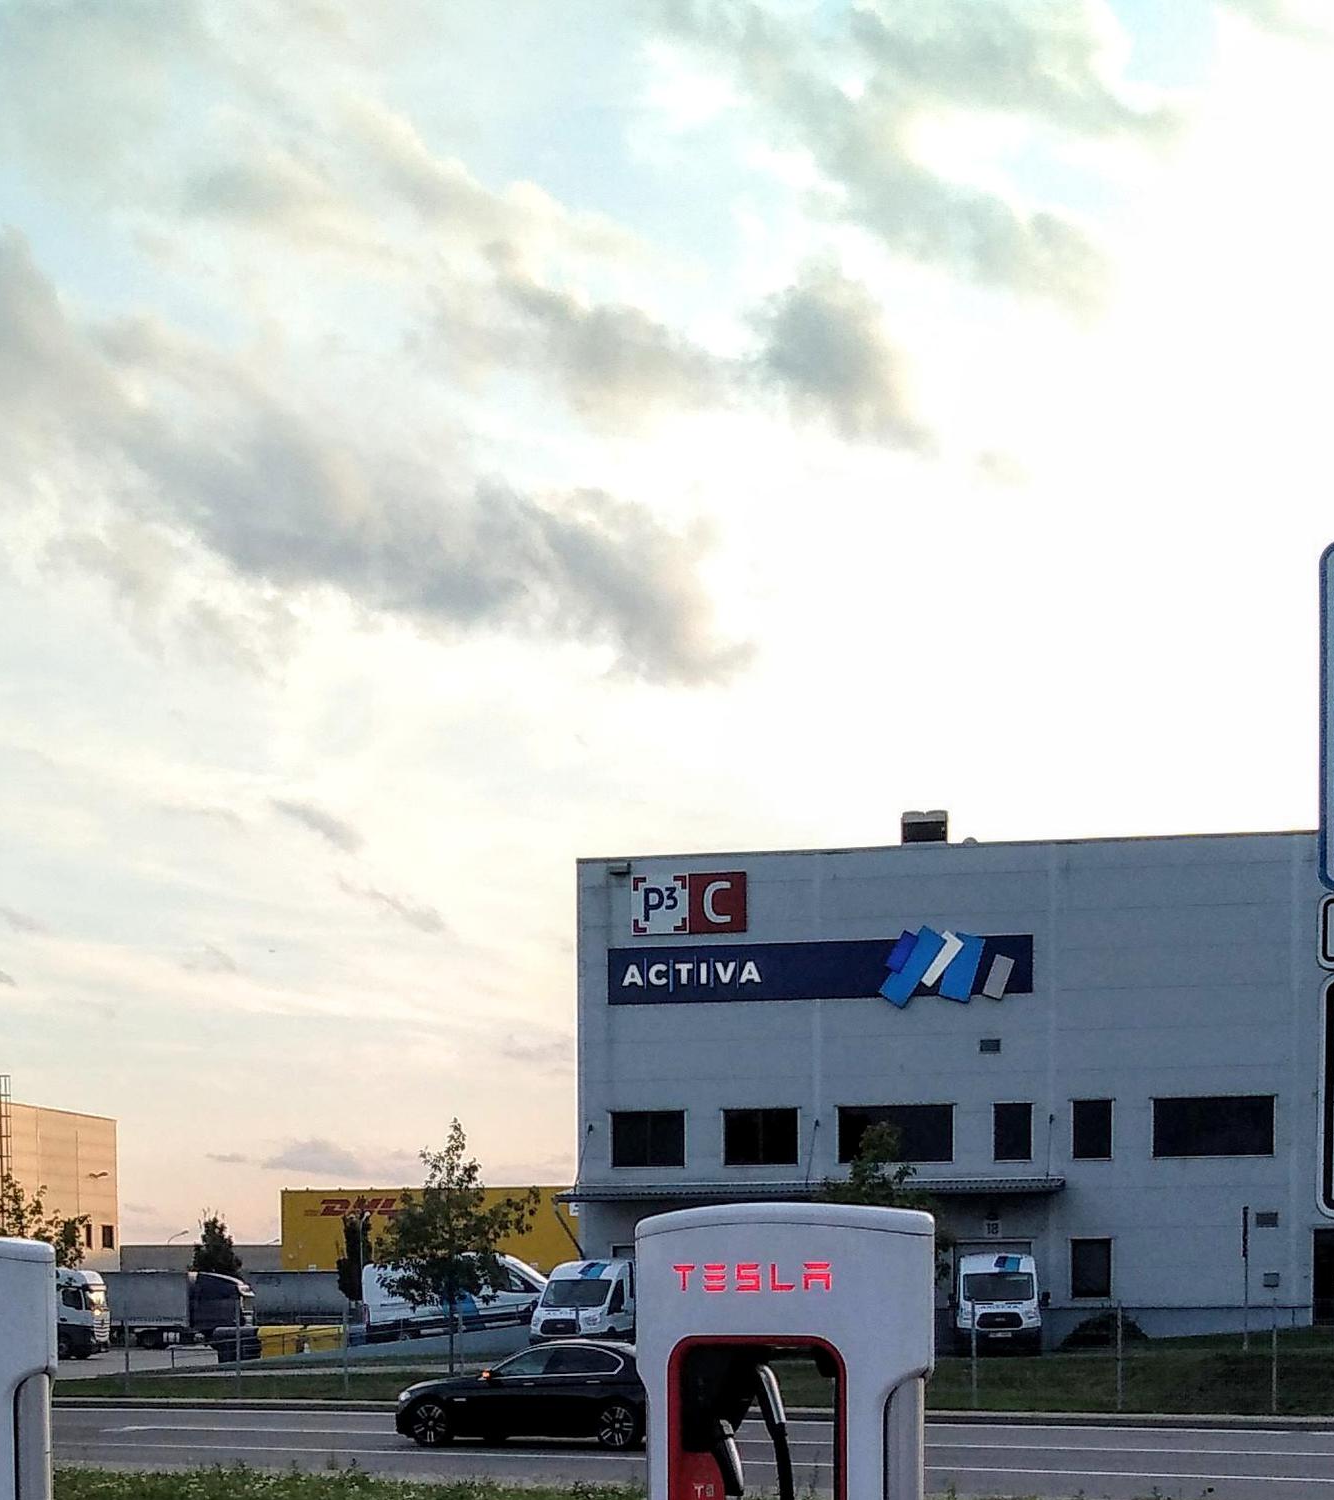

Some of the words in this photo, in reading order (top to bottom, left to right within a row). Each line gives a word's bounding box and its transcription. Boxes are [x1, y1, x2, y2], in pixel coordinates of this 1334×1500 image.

[702, 880, 732, 924] C
[621, 961, 762, 987] ACTIVA
[986, 1222, 999, 1235] 18
[674, 1261, 832, 1293] TESLA
